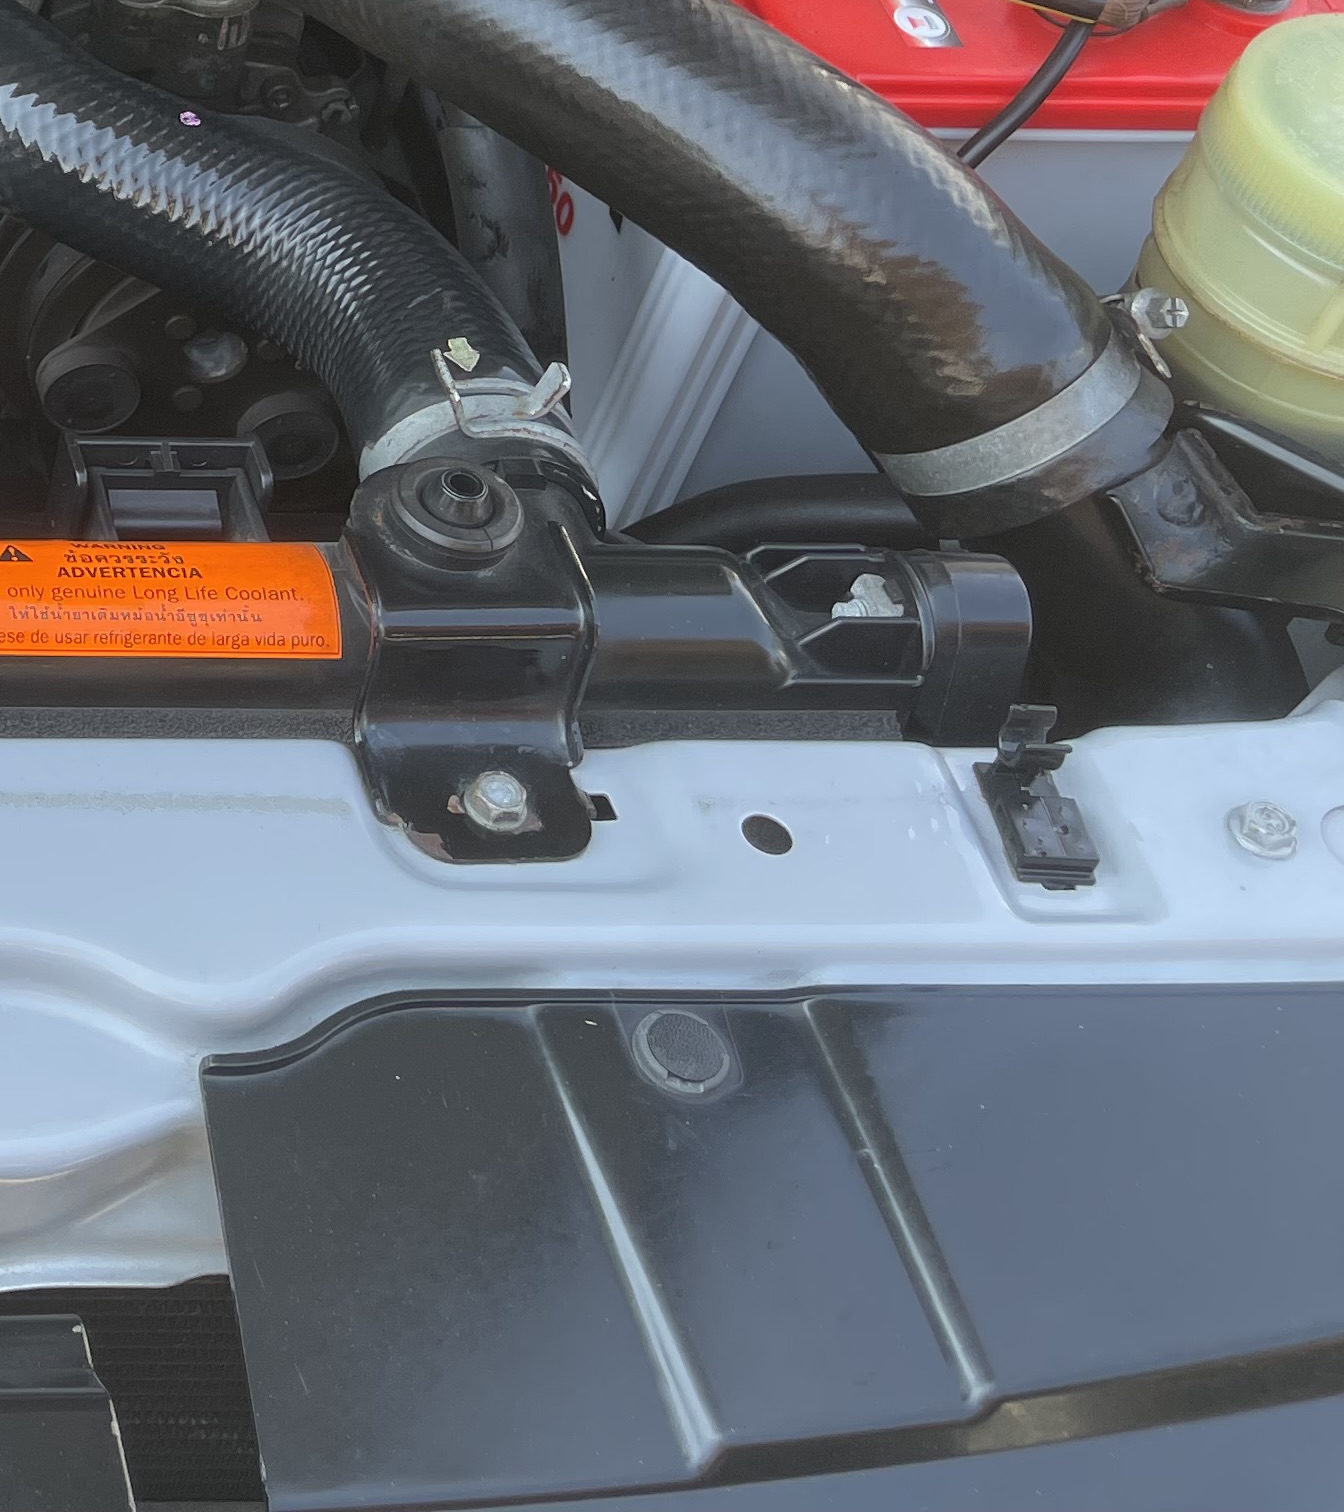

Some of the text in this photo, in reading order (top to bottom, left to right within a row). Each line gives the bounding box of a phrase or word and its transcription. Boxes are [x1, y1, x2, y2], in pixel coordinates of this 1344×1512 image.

[64, 550, 184, 565] ข้อควรระวัง
[57, 567, 203, 579] ADVERTENCIA
[7, 584, 45, 601] only
[52, 586, 126, 602] genuine
[133, 586, 179, 603] Long
[184, 586, 218, 600] Life
[225, 586, 304, 601] Coolant.
[30, 629, 49, 644] de
[55, 632, 89, 645] usar
[94, 629, 182, 649] refrigerante
[187, 631, 206, 646] de
[212, 632, 249, 649] larga
[255, 632, 286, 646] vida
[291, 635, 330, 649] puro.
